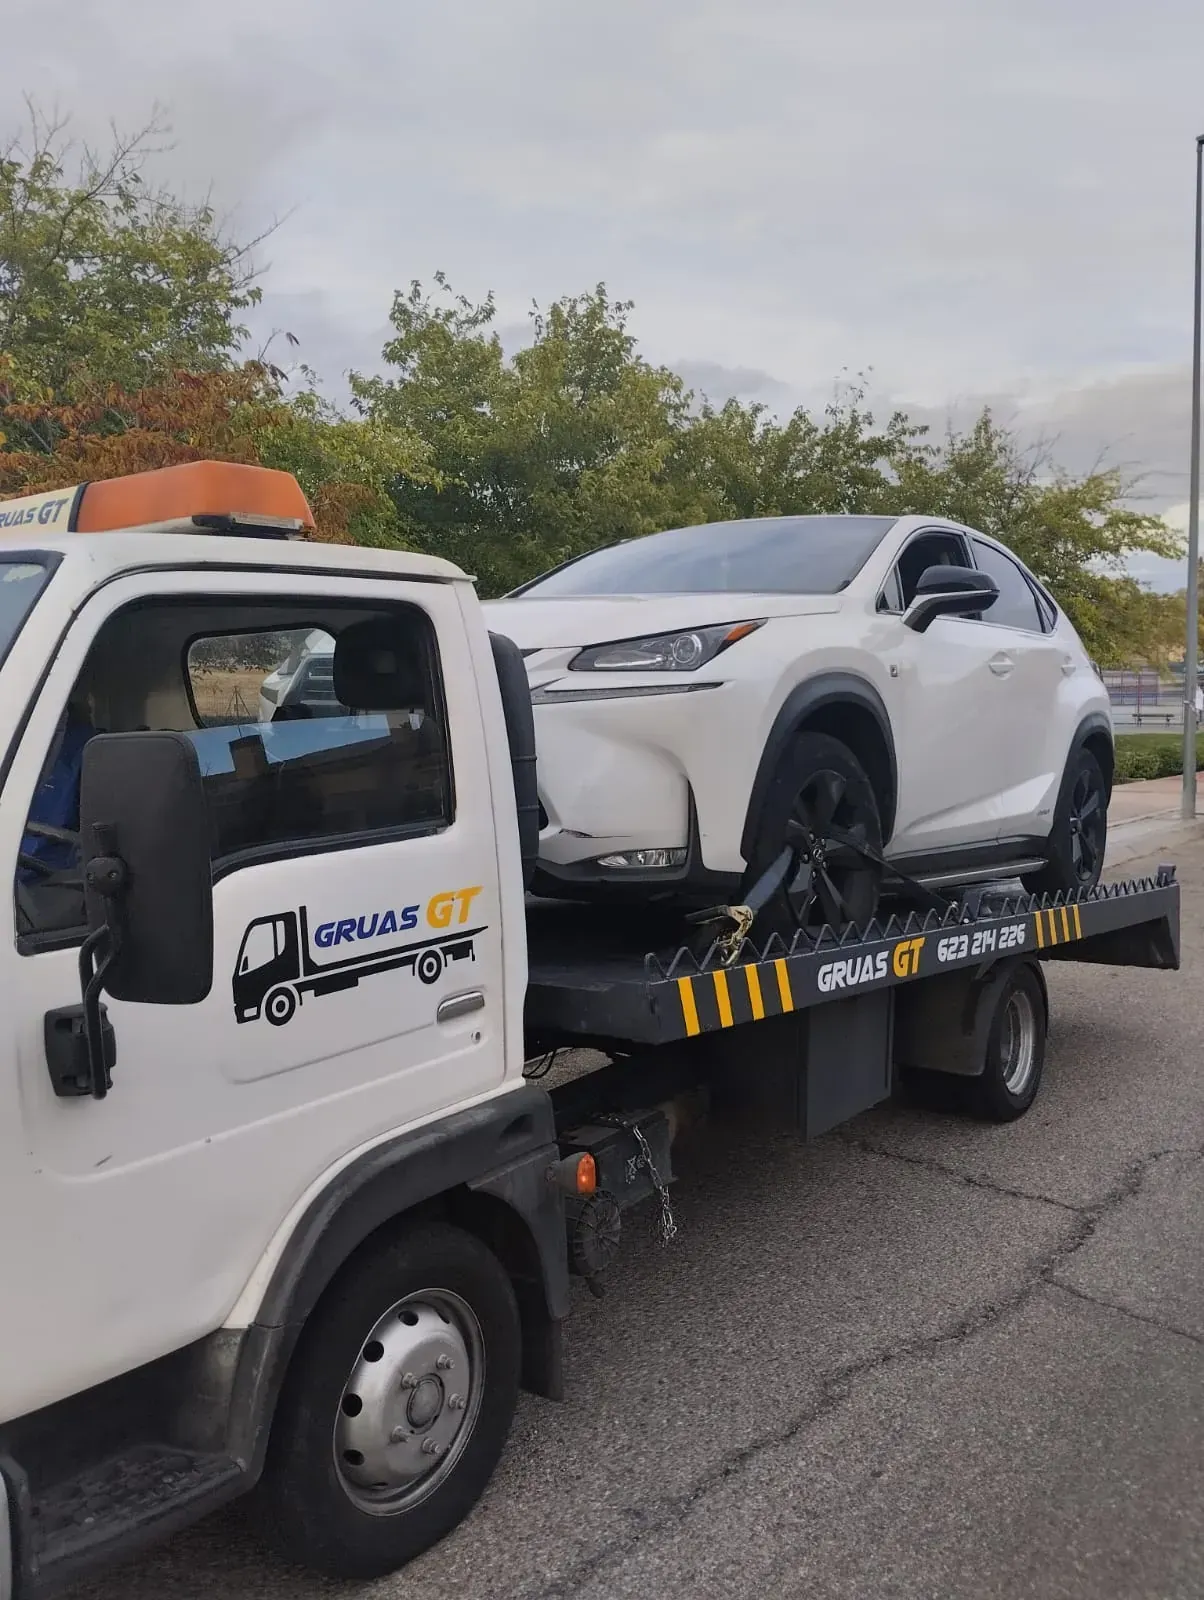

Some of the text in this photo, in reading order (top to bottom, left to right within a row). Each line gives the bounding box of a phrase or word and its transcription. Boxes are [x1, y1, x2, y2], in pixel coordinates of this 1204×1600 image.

[38, 498, 70, 525] GT
[314, 885, 484, 948] GRUAS GT
[817, 923, 1026, 992] GRUAS GT 623 214 226
